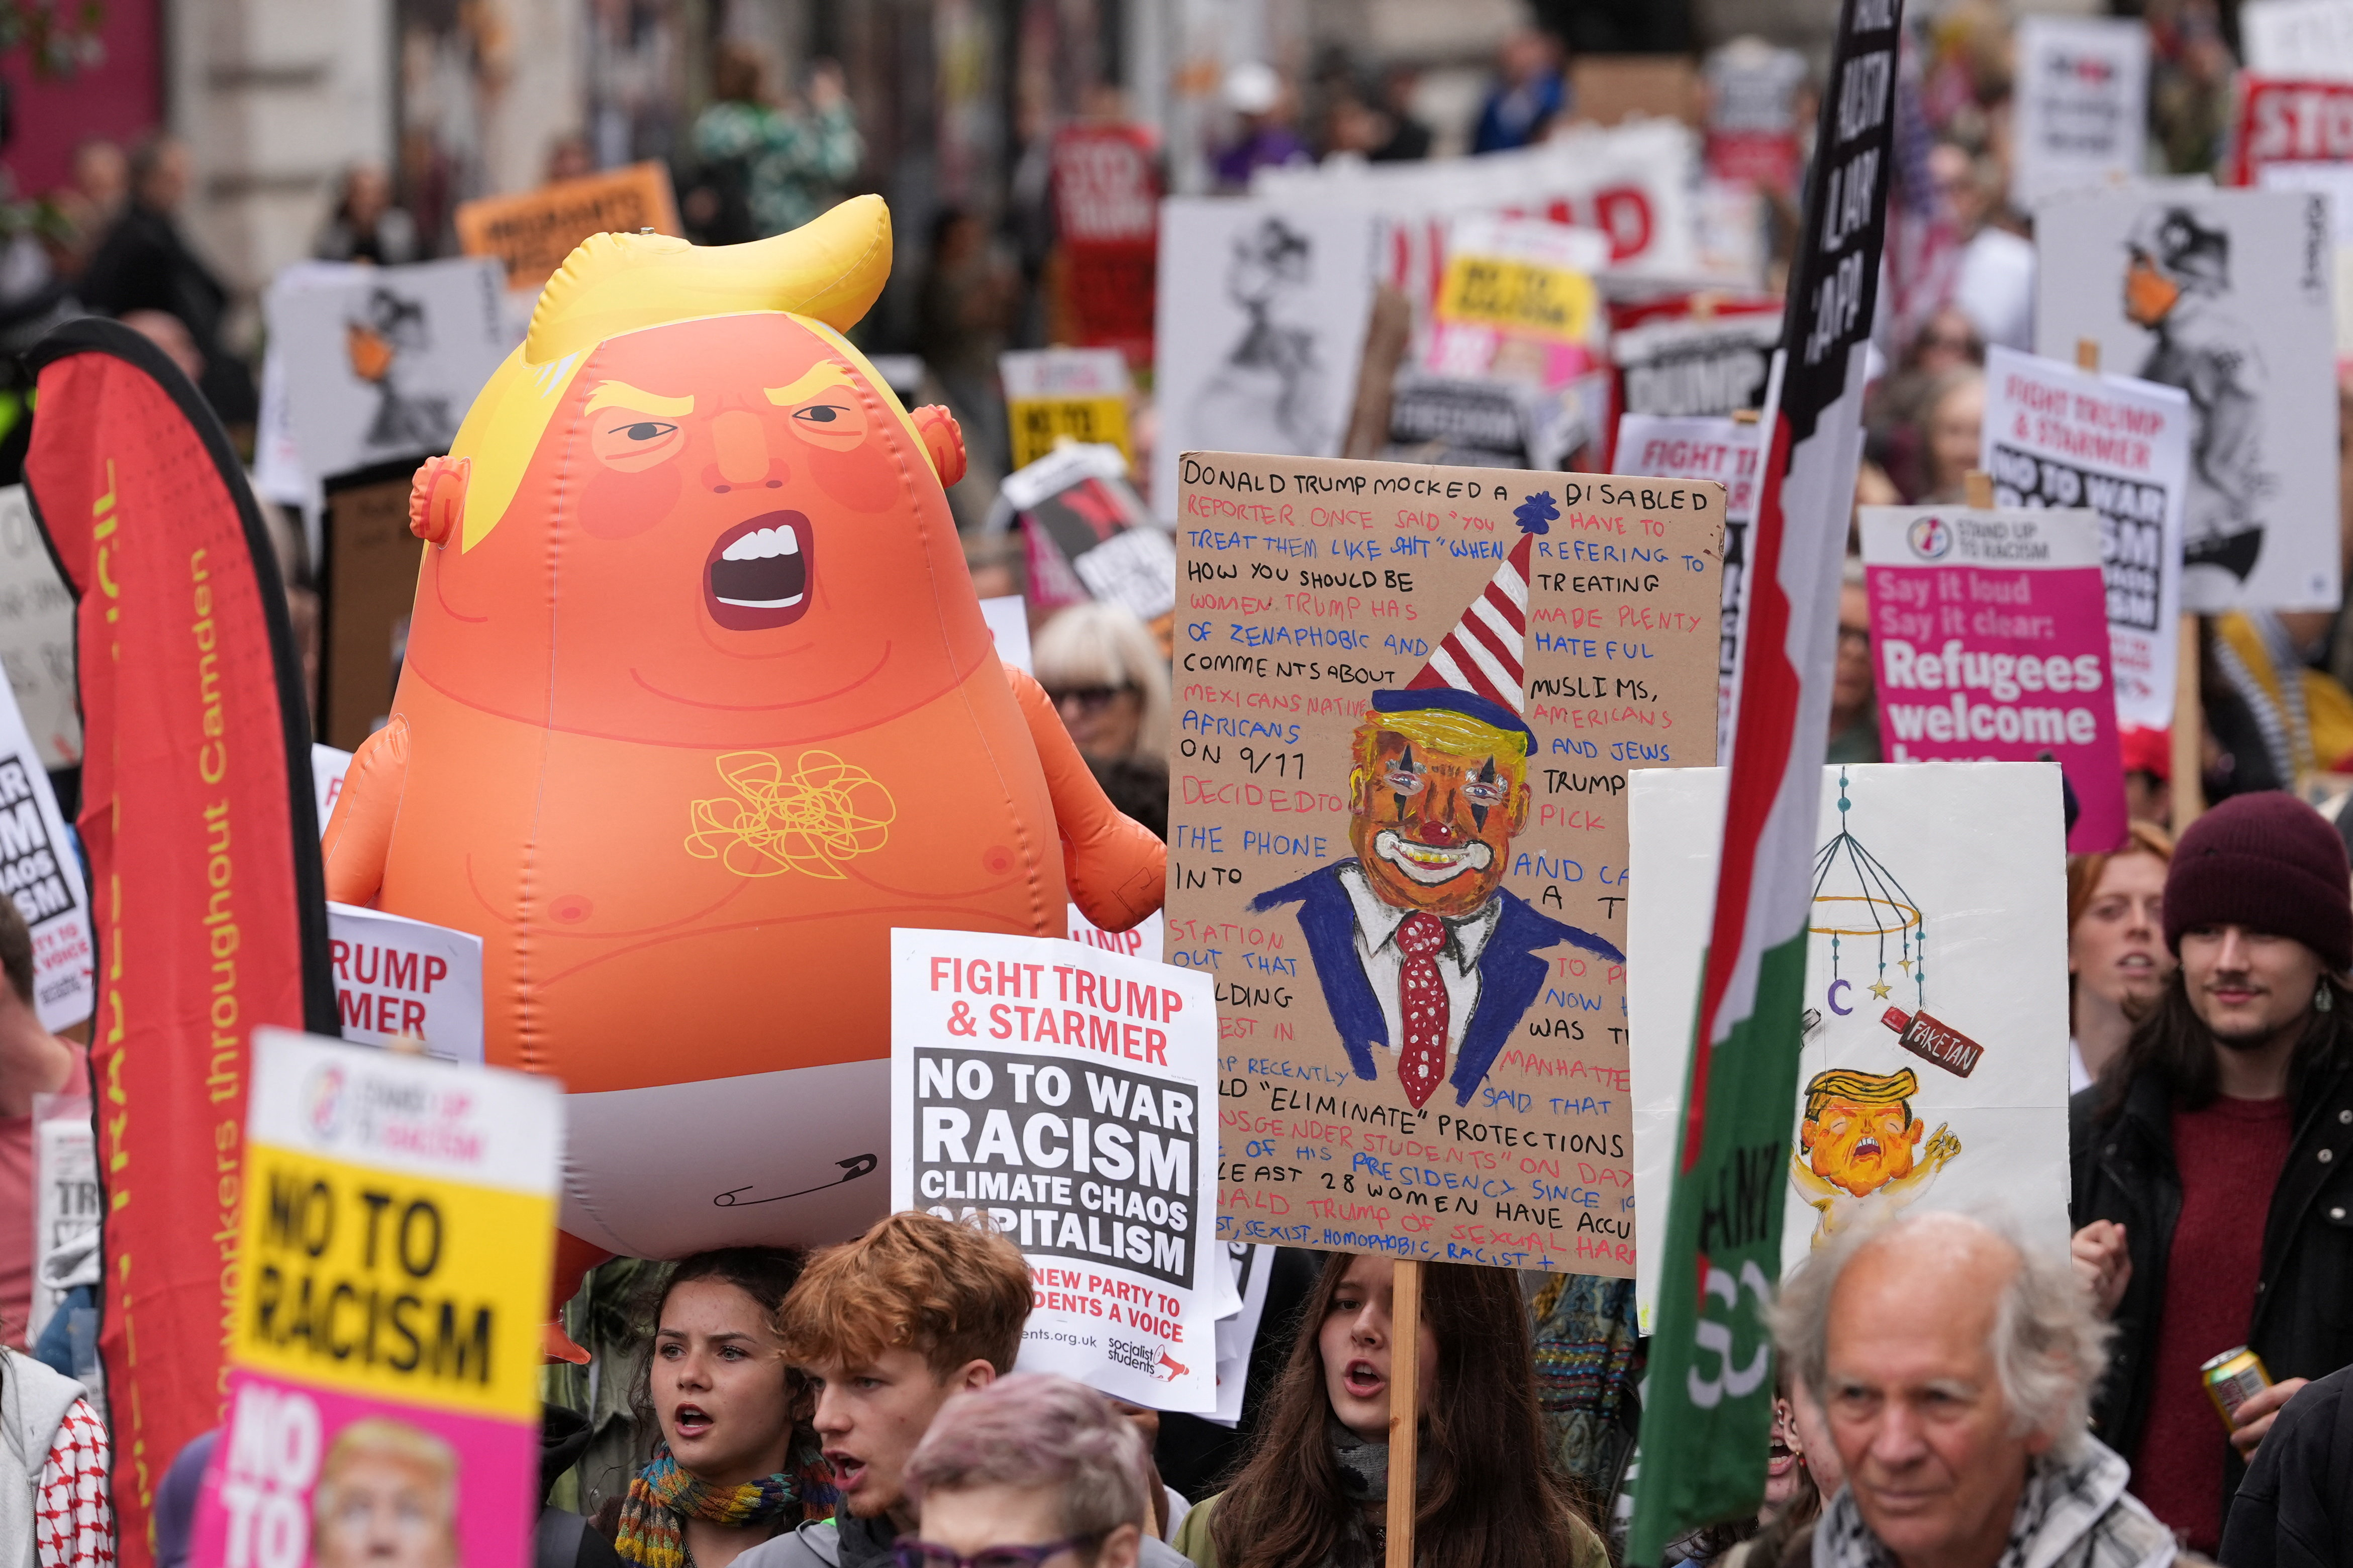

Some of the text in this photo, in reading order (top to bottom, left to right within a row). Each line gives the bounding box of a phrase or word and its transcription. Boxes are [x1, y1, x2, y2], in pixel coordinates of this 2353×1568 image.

[2006, 376, 2165, 436] FIGHT TRUMP
[1642, 439, 1726, 473] FIGHT
[2038, 421, 2150, 472] STARMER
[1185, 460, 1285, 493] DONALD
[1294, 475, 1366, 495] TRUMP
[1374, 476, 1481, 498] MOCKED
[1494, 486, 1507, 500] A
[1566, 484, 1707, 510] DISABLED
[1993, 450, 2036, 491] NO
[2040, 465, 2082, 506] TO
[2086, 475, 2164, 525] WAR
[1188, 494, 1295, 526] REPORTER
[1311, 507, 1374, 530] ONCE
[1395, 509, 1439, 531] SAID
[1571, 512, 1626, 535] HAVE
[1640, 519, 1665, 537] TO
[2014, 521, 2036, 539] UP
[1188, 529, 1257, 550] TREAT
[1263, 537, 1318, 558] THEM
[1332, 539, 1382, 561] LIKE
[1539, 541, 1669, 563] REFERING
[1682, 555, 1704, 572] TO
[1188, 560, 1659, 592] HOW YOU SHOULD BE TREATING
[1191, 592, 1701, 633] WOMEN TRUMP HAS MADE PLENTY
[1876, 572, 2030, 609] Say it loud
[1189, 621, 1212, 642] OF
[1230, 624, 1369, 650] ZENAPHOBIC
[1384, 634, 1428, 656] AND
[1879, 605, 2053, 643] Say it clear:
[191, 547, 228, 784] Camden
[1184, 653, 1657, 702] COMMENTS ABOUT MUSLIMS,
[1882, 639, 2102, 702] Refugees
[1184, 683, 1673, 729] MEXICANS NATIVE AMERICANS
[1887, 692, 2096, 745] welcome
[1183, 709, 1670, 762] AFRICANS AND JEWS
[1181, 739, 1626, 795] ON 9/11 TRUMP
[1541, 804, 1605, 831] PICK
[1177, 825, 1584, 882] THE PHONE AND
[1177, 862, 1562, 910] INTO A
[202, 797, 240, 1104] throughout
[1169, 919, 1284, 951] STATION
[1558, 958, 1586, 977] TO
[930, 956, 1183, 1023] FIGHT TRUMP
[1174, 949, 1223, 969] OUT
[1242, 953, 1297, 977] THAT
[1545, 989, 1602, 1012] NOW
[947, 1000, 1168, 1067] & STARMER
[1274, 1022, 1294, 1041] IN
[1530, 1018, 1584, 1040] WAS
[919, 1057, 1194, 1134] NO TO WAR
[1248, 1058, 1349, 1087] RECENTLY
[1483, 1088, 1531, 1113] SAID
[1549, 1097, 1611, 1115] THAT
[922, 1106, 1190, 1197] RACISM
[1438, 1115, 1624, 1158] PROTECTIONS
[1246, 1139, 1277, 1158] OF
[1297, 1147, 1332, 1161] HIS
[1353, 1152, 1515, 1198] PRESIDENCY
[1532, 1180, 1600, 1208] SINCE
[1520, 1158, 1559, 1178] ON
[262, 1167, 446, 1280] NO TO
[920, 1170, 1188, 1232] CLIMATE CHAOS
[1218, 1162, 1631, 1239] LEAST 28 WOMEN HAVE ACCU
[1307, 1198, 1390, 1230] TRUMP
[1402, 1213, 1436, 1233] OF
[1451, 1225, 1566, 1253] SEXUAL
[1448, 1242, 1528, 1266] RACIST
[1032, 1268, 1181, 1318] NEW PARTY TO
[255, 1262, 495, 1388] RACISM
[1108, 1337, 1154, 1362] socialist
[1109, 1303, 1122, 1323] A
[1128, 1309, 1184, 1344] VOICE
[1108, 1348, 1155, 1375] students
[229, 1382, 324, 1495] NO
[221, 1480, 312, 1568] TO
